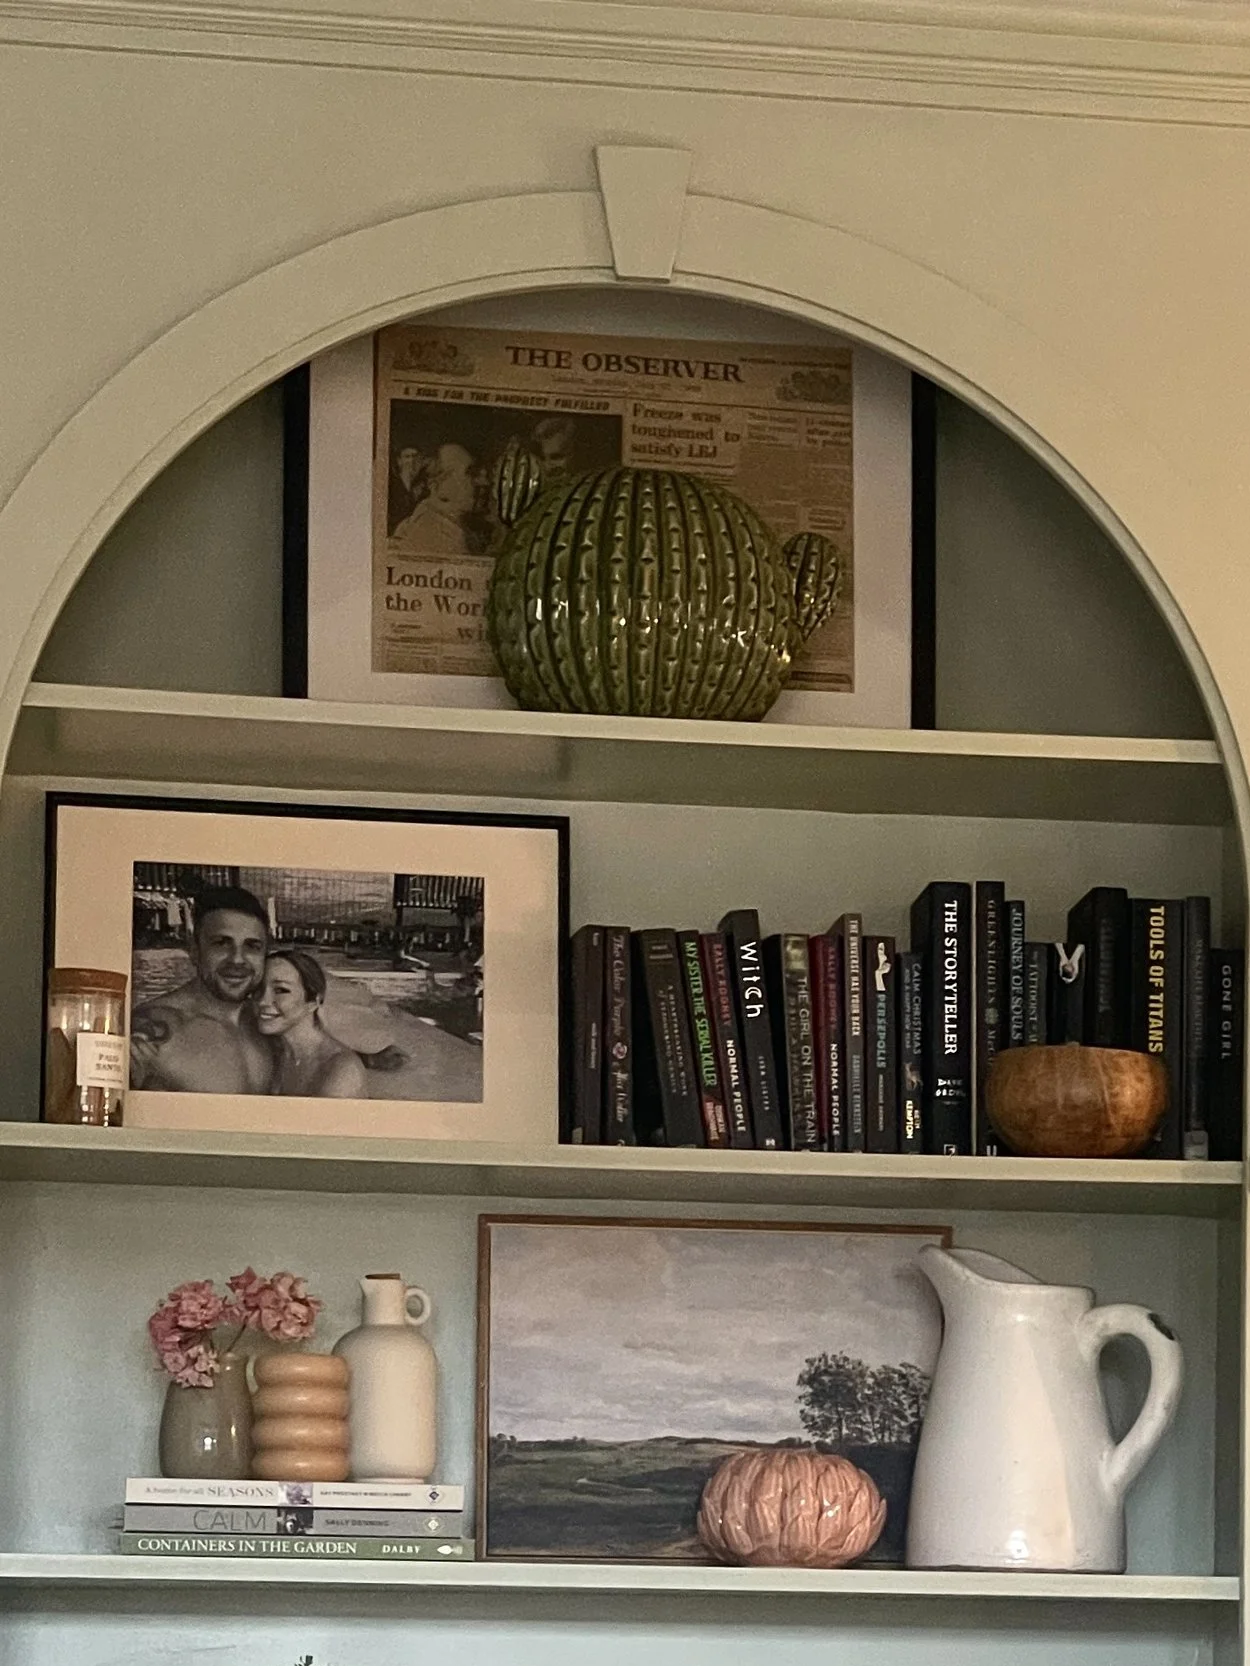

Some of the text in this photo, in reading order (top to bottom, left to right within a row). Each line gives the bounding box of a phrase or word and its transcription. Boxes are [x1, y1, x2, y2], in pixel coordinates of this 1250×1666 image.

[505, 345, 574, 370] THE
[581, 353, 745, 383] OBSERVER
[470, 390, 490, 401] THE
[632, 402, 723, 424] Freeze was
[630, 442, 682, 459] satisfy
[631, 423, 741, 443] toughened to
[385, 566, 473, 592] London
[385, 592, 422, 612] the
[685, 941, 697, 960] MY
[713, 944, 727, 979] SALLY
[986, 900, 998, 1005] GREENLIGHTS
[612, 935, 625, 1036] The Color Purple
[850, 919, 860, 1036] THE UNIVERSE HAS YOUR BACK
[943, 900, 958, 1056] THE STORYTELLER
[1011, 908, 1024, 1041] JOURNEY OF SOULS
[1028, 964, 1039, 1022] TATTOOIST
[1148, 906, 1165, 1054] TOOLS OF TITANS
[692, 998, 706, 1016] THE
[912, 963, 922, 1056] CALM CHRISTMAS
[1221, 965, 1233, 1059] GONE GIRL
[695, 1018, 713, 1050] SERIAL
[876, 993, 887, 1069] PERSEPOLIS
[700, 1050, 718, 1088] KILLER
[797, 976, 817, 1144] THE GIRL ON THE TRAIN
[726, 1039, 746, 1133] NORMAL PEOPLE
[830, 1043, 841, 1137] NORMAL PEOPLE
[906, 1100, 914, 1140] KEMPTON
[206, 1486, 274, 1498] SEASONS
[192, 1509, 267, 1532] CALM
[137, 1538, 357, 1555] CONTAINERS IN THE GARDEN
[382, 1544, 421, 1555] DALBY
